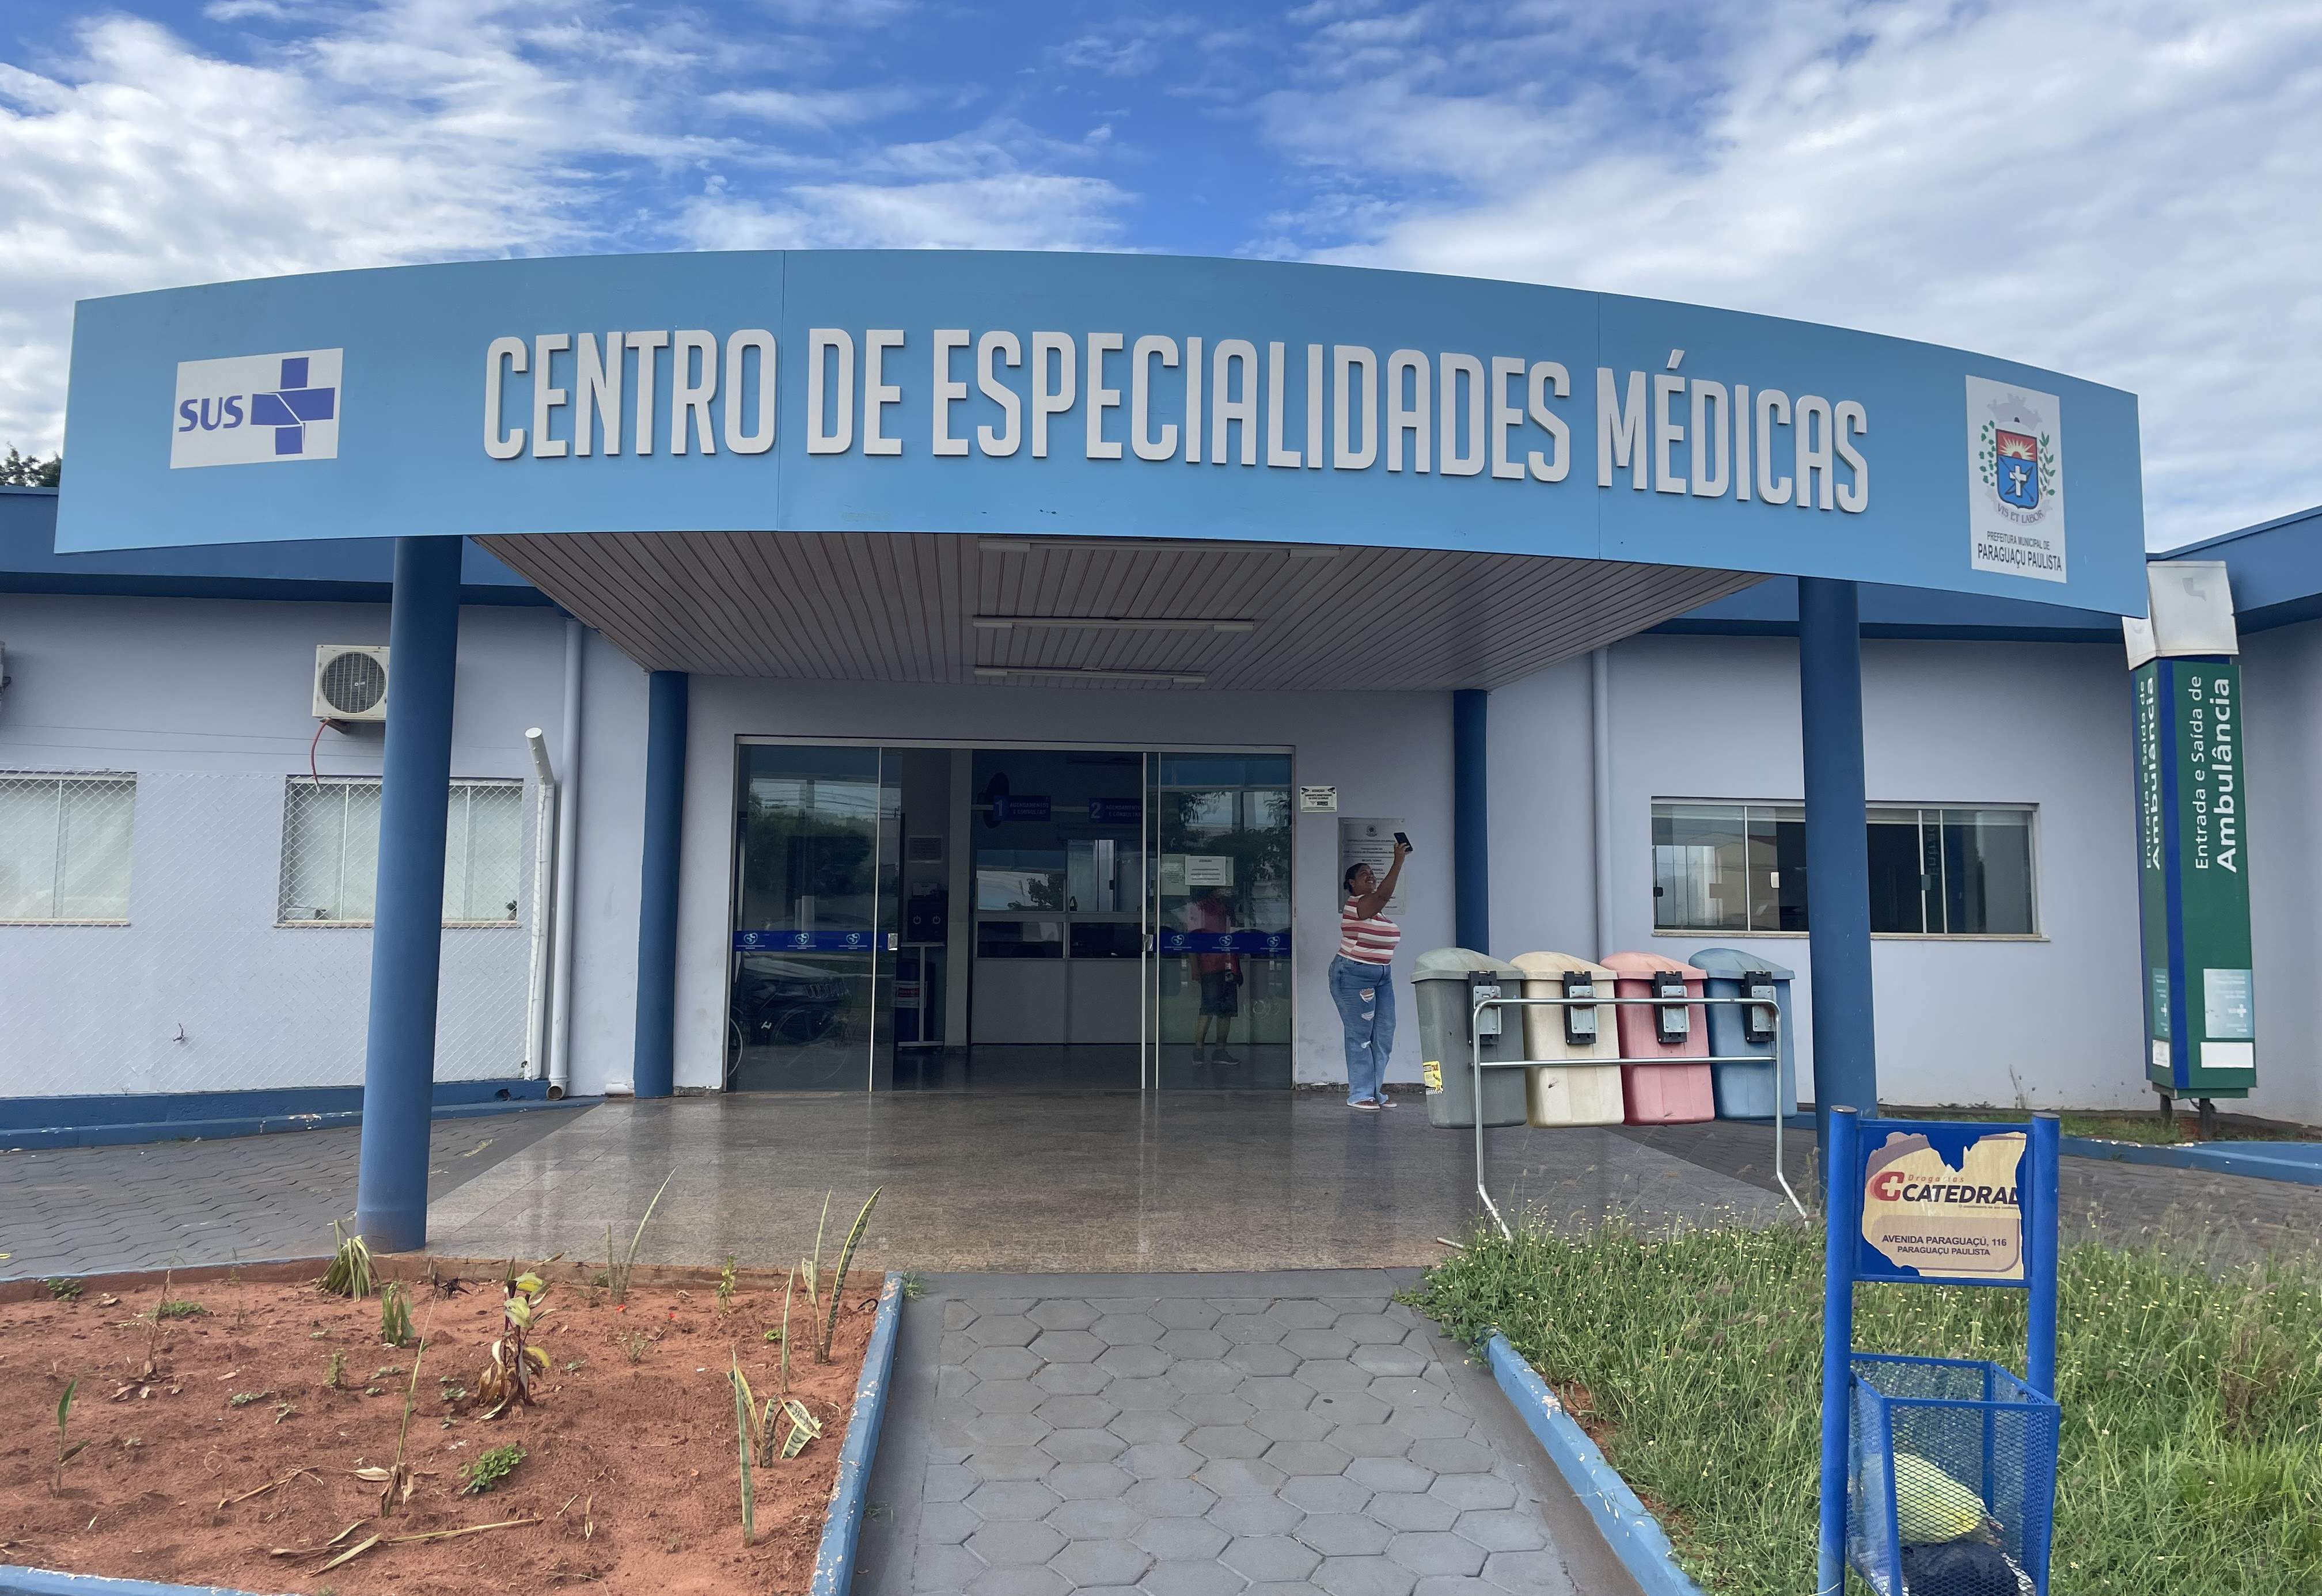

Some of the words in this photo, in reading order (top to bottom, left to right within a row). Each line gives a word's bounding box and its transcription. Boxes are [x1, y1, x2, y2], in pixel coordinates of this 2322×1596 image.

[179, 395, 244, 432] SUS
[484, 329, 777, 460] CENTRO
[807, 328, 906, 457] DE
[932, 329, 1571, 483] ESPECIALIDADES
[1596, 348, 1869, 514] MÉDICAS
[1997, 503, 2009, 517] VIS
[2010, 512, 2020, 522] ET
[2021, 510, 2044, 523] LABOR
[1987, 531, 2017, 544] PREFEITURA
[2018, 536, 2043, 549] MUNICIPAL
[2043, 541, 2050, 550] DE
[1978, 543, 2025, 568] PARAGUAÇU
[2028, 551, 2062, 571] PAULISTA
[2139, 681, 2145, 705] de
[2188, 676, 2202, 701] de
[2189, 709, 2205, 762] Saída
[2143, 772, 2149, 783] e
[2195, 770, 2205, 781] e
[2209, 679, 2237, 873] Ambulância
[995, 800, 1003, 816] 1
[1091, 802, 1101, 819] 2
[2143, 791, 2152, 868] Entrada
[2192, 789, 2209, 869] Entrada
[1882, 1234, 1923, 1244] AVENIDA
[1991, 1238, 2006, 1247] 116
[1897, 1246, 1949, 1256] PARAGUAÇU
[1951, 1248, 1990, 1256] PAULISTA
